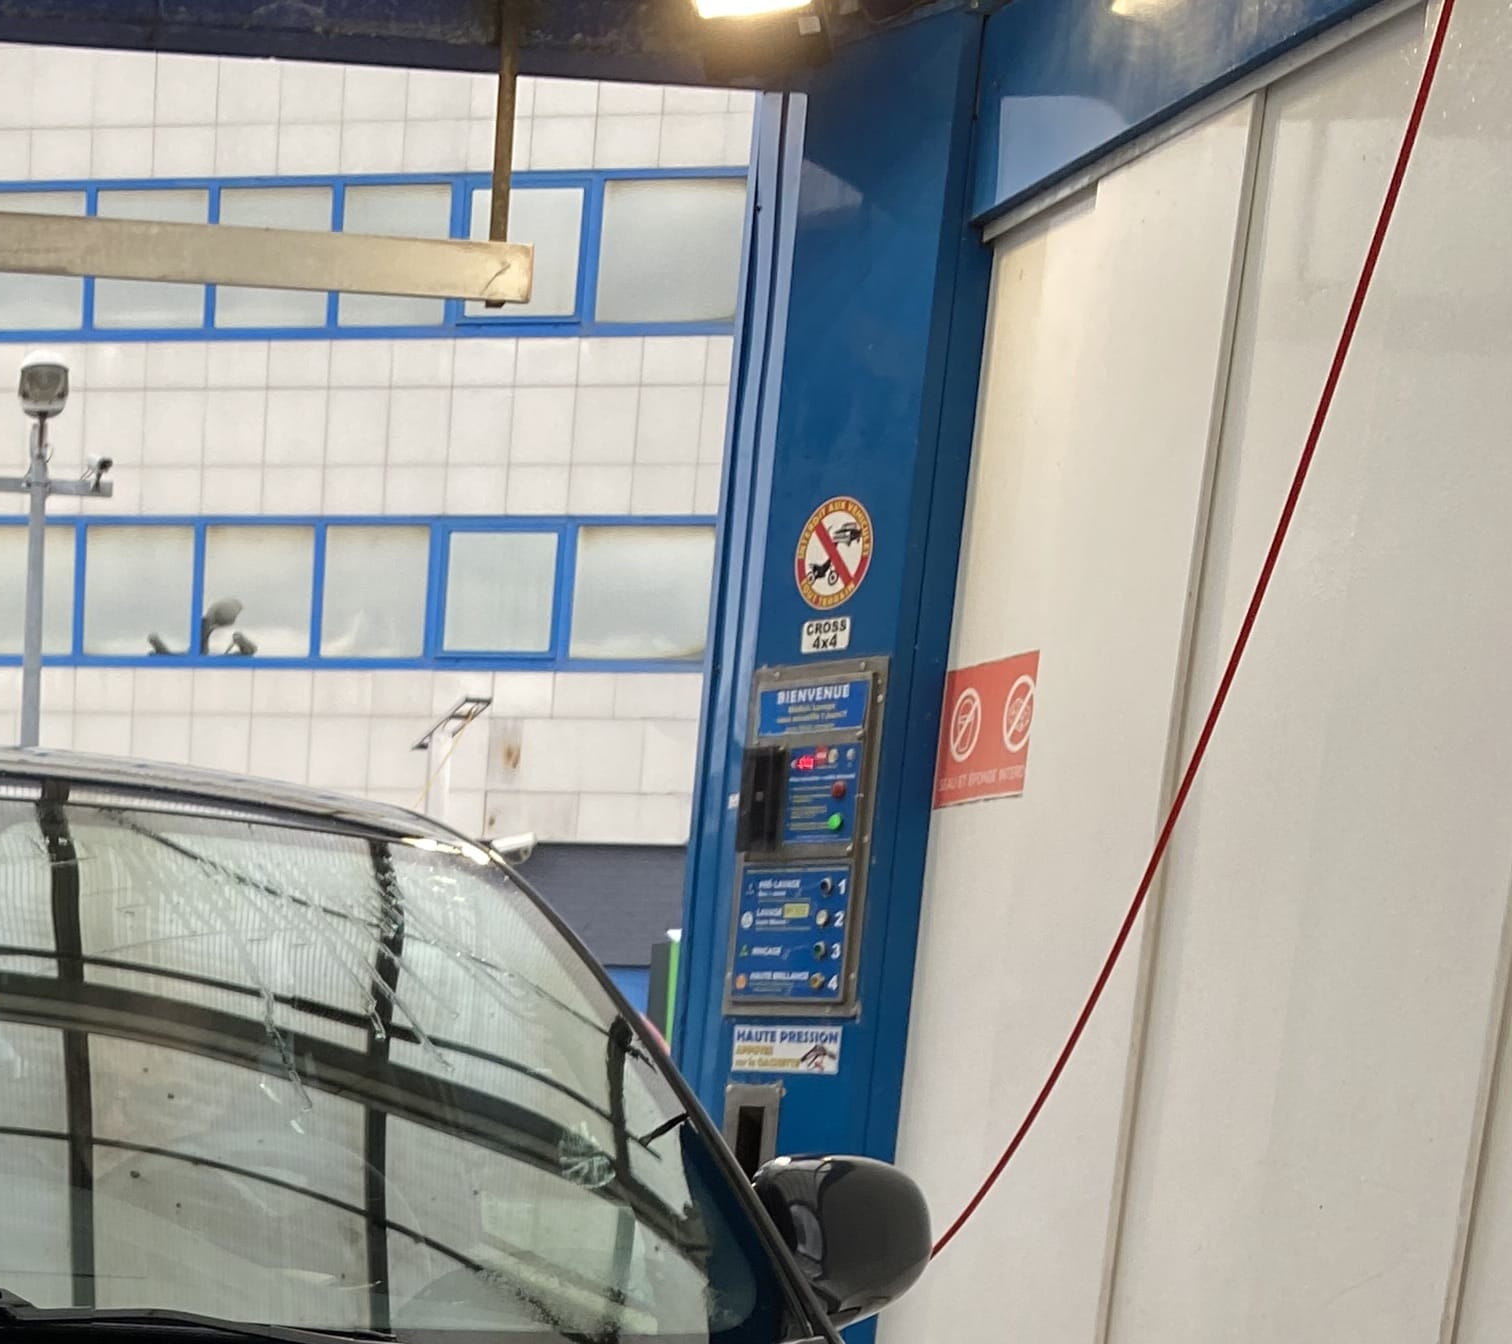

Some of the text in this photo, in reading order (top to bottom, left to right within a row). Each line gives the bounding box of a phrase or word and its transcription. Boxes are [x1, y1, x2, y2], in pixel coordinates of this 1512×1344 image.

[806, 618, 847, 636] CROSS
[812, 633, 838, 650] 4x4
[777, 683, 850, 705] BIENVENUE
[838, 879, 847, 895] 1
[833, 911, 846, 928] 2
[830, 942, 841, 960] 3
[827, 974, 839, 991] 4
[736, 1030, 839, 1045] HAUTE PRESSION
